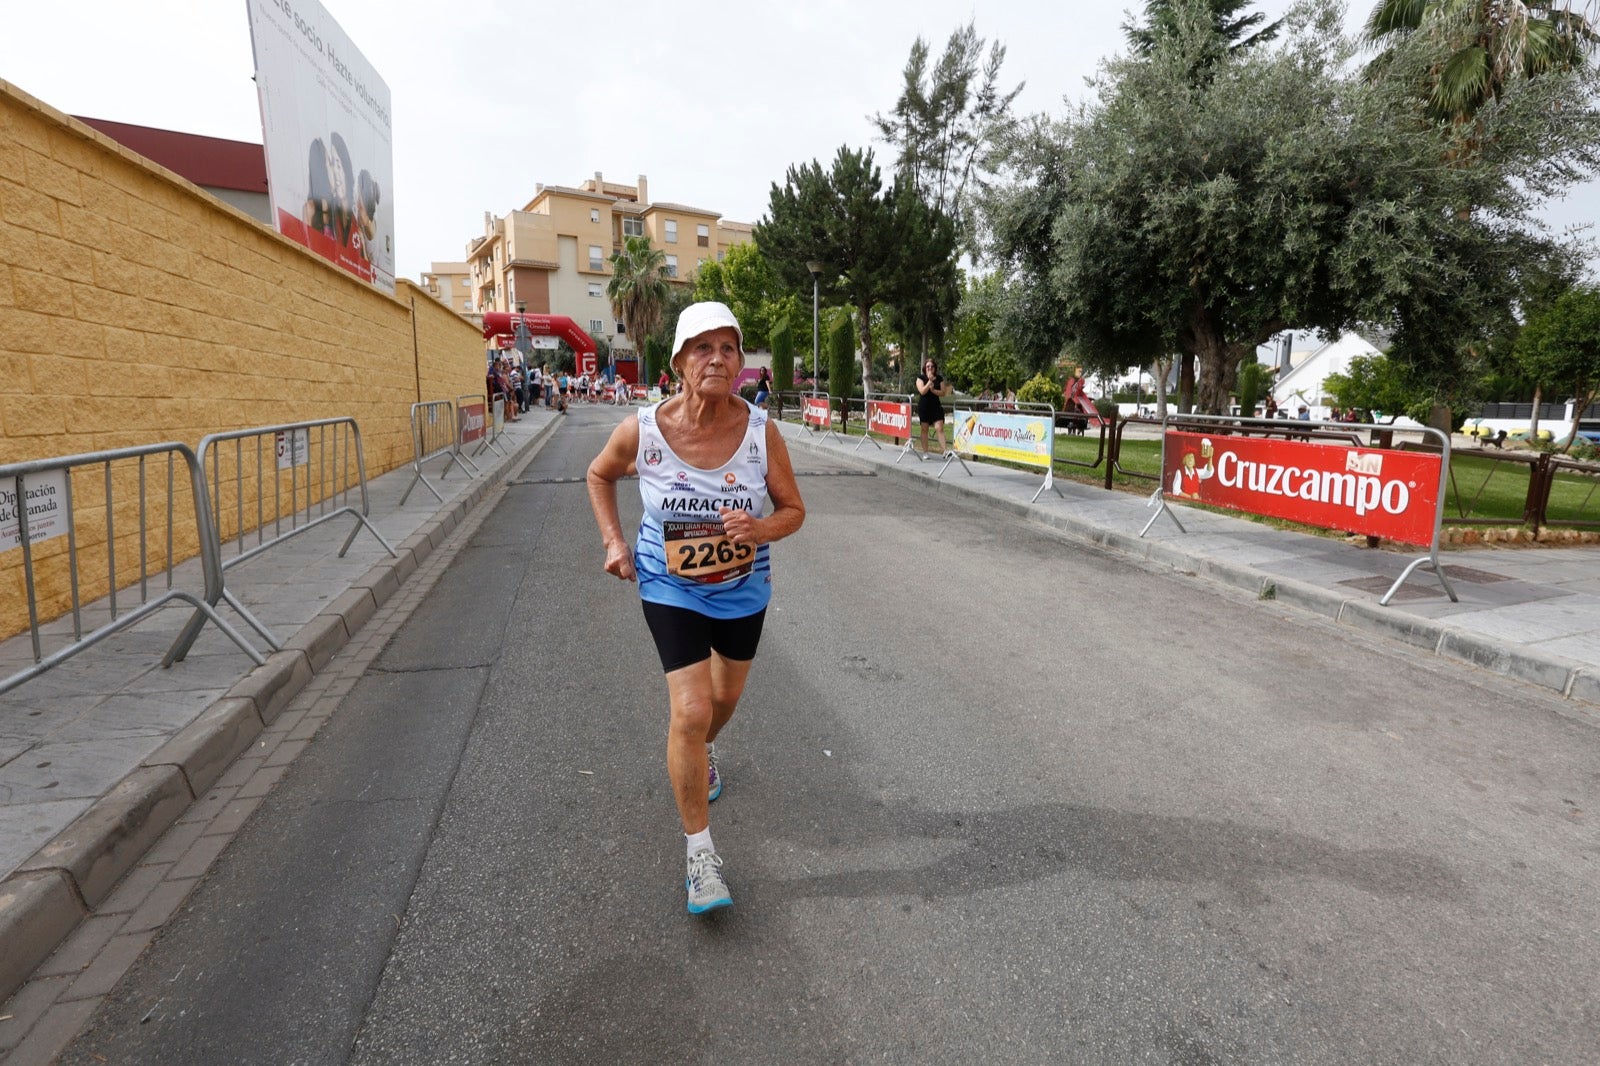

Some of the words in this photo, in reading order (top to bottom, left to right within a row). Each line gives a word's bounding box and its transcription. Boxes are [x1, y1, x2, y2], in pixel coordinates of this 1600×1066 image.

[294, 11, 326, 56] socio.
[327, 43, 353, 86] Hazte
[876, 408, 908, 430] Cruzcampo
[978, 423, 1013, 441] Cruzcampo
[0, 484, 56, 505] Diptación
[661, 497, 753, 511] MARACENA
[12, 499, 57, 519] Ganada
[678, 540, 752, 570] 2265
